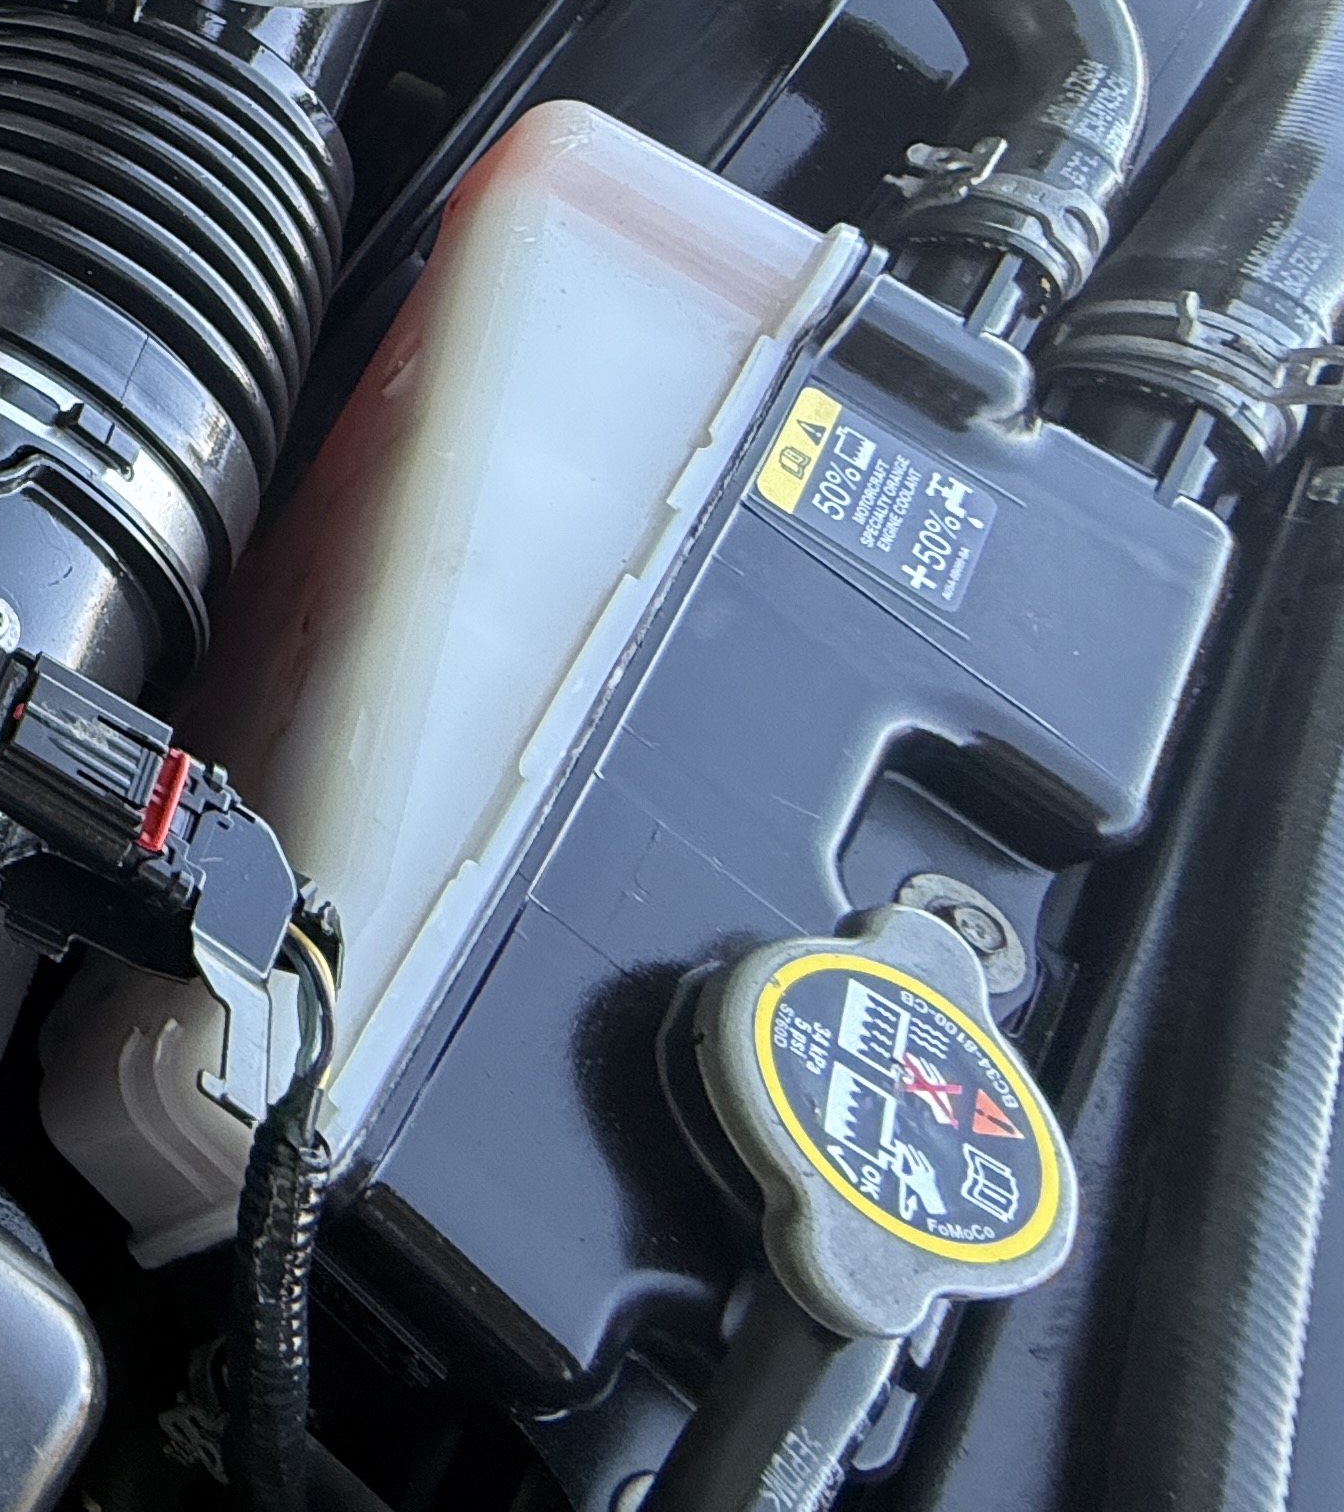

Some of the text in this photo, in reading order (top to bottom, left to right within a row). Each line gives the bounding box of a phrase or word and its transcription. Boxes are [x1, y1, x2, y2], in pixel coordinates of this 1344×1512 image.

[812, 461, 862, 521] 50%
[850, 457, 891, 526] MOTORCRAFT
[858, 452, 911, 549] SPECIALTY ORANGE
[875, 466, 923, 553] ENGINE COOLANT
[789, 1017, 812, 1059] 5 psi
[805, 1022, 832, 1075] 34 kPa
[900, 990, 1019, 1110] BC34-8100-CB
[860, 1165, 882, 1201] OK
[926, 1218, 996, 1241] FoMoCo
